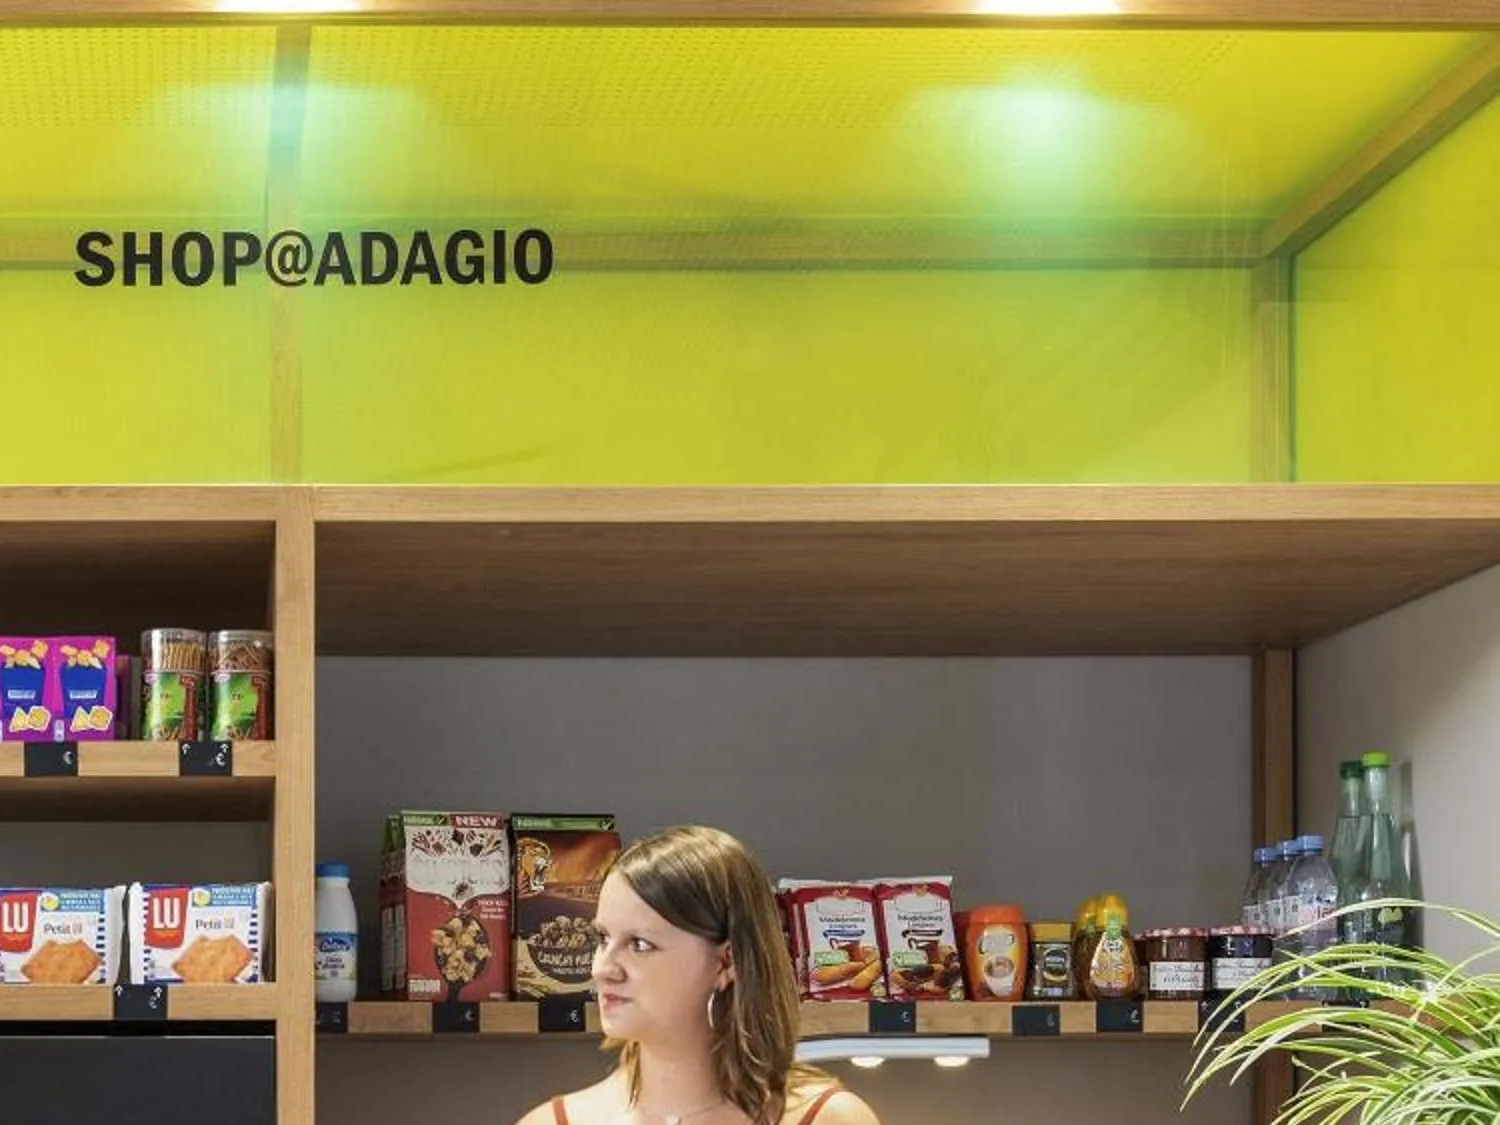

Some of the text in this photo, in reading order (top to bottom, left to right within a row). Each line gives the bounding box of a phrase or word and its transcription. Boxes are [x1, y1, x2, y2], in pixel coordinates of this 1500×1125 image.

[74, 228, 554, 288] SHOP@ADAGIO
[455, 815, 498, 827] NEW
[2, 901, 30, 933] LU
[153, 897, 181, 930] LU
